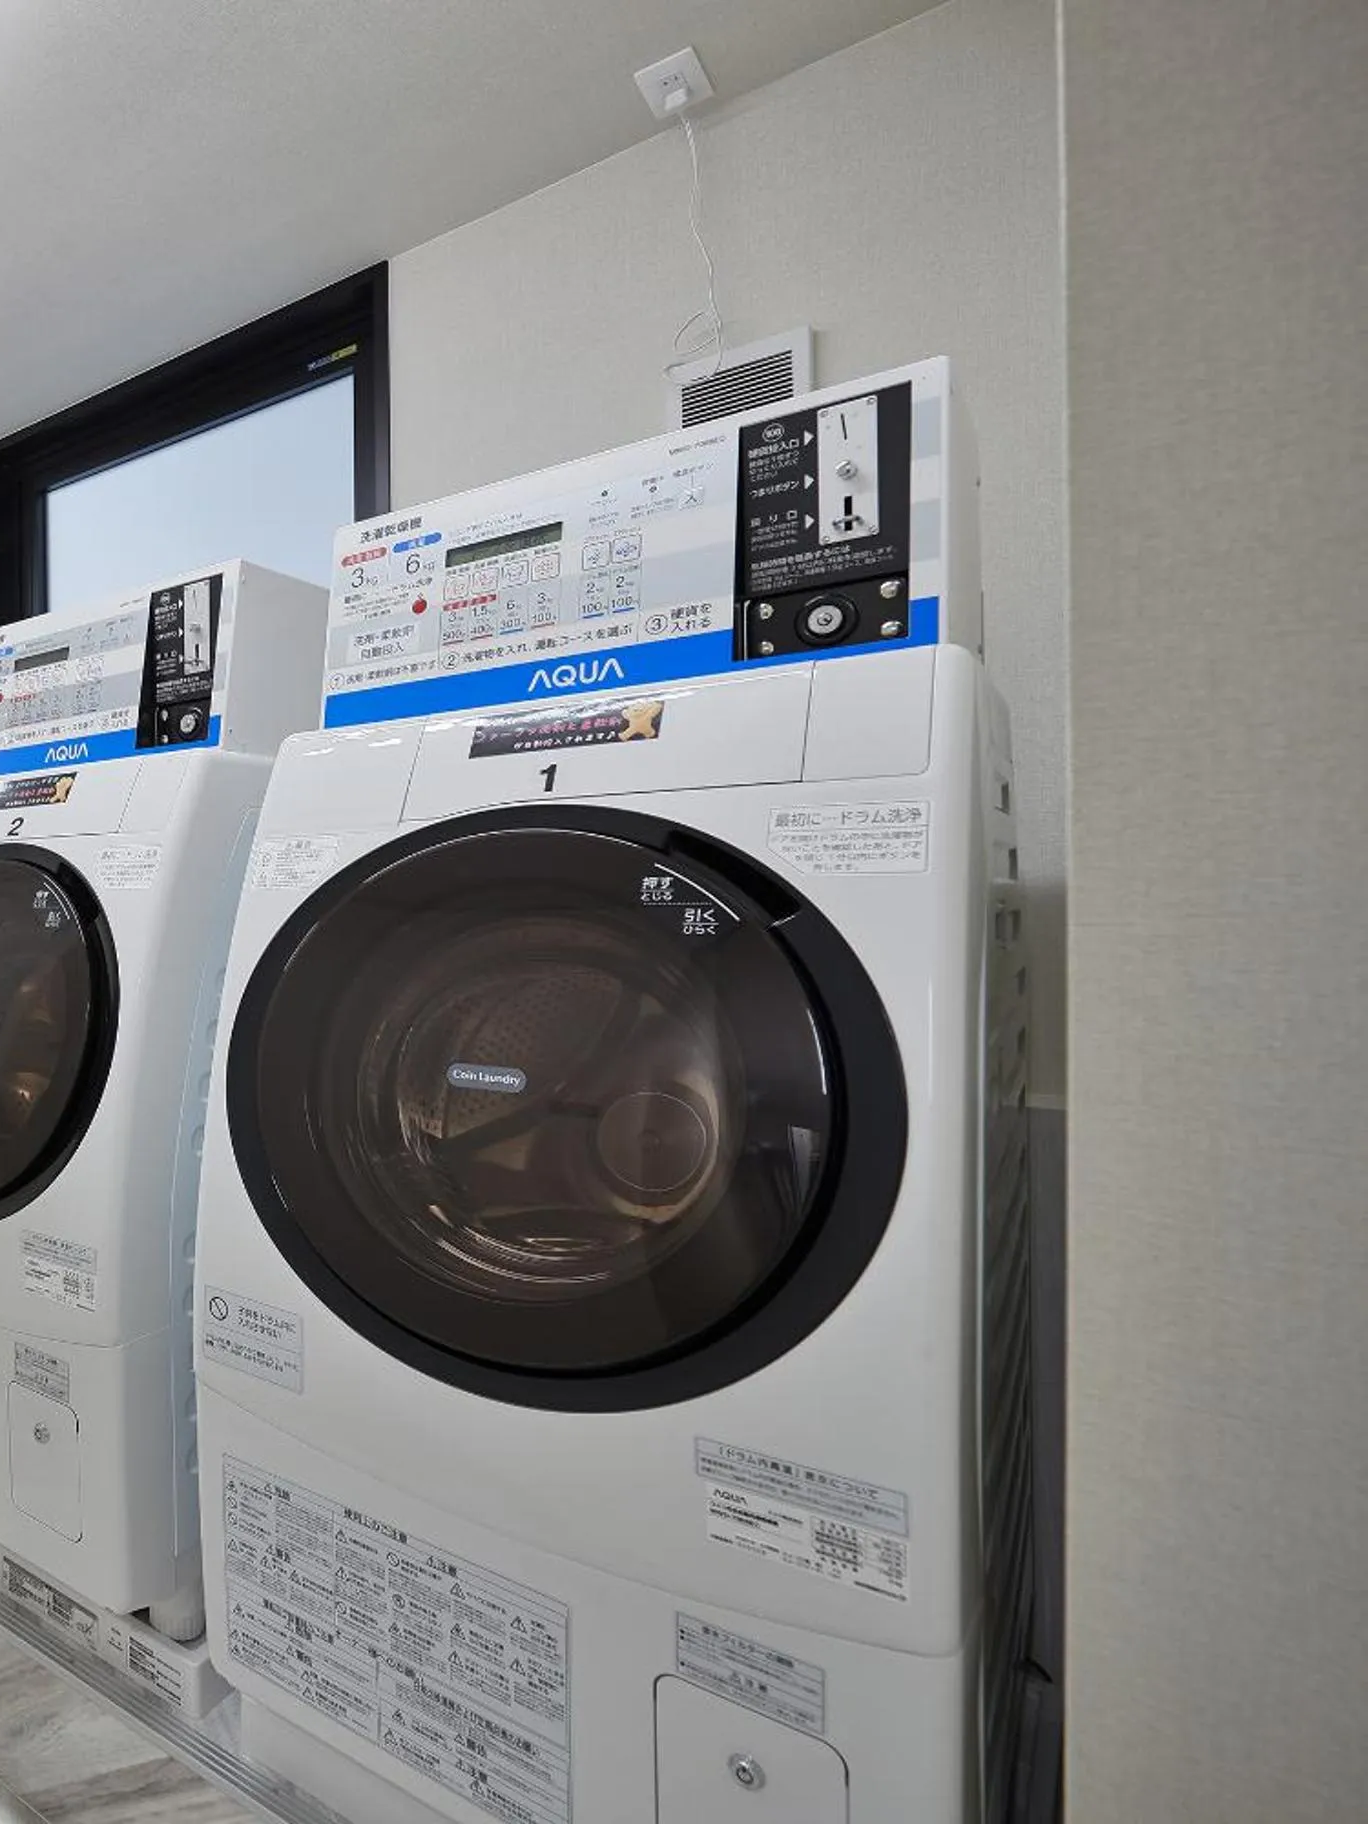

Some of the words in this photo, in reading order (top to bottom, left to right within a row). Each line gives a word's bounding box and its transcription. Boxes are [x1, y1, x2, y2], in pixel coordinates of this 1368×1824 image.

[528, 658, 624, 692] AQUA
[45, 743, 89, 763] AQUA
[540, 764, 557, 792] 1
[7, 817, 24, 836] 2
[642, 877, 674, 890] 押す
[684, 909, 715, 923] 引く
[683, 925, 716, 935] ひらく
[453, 1070, 477, 1080] Coin
[479, 1072, 520, 1087] Laundry
